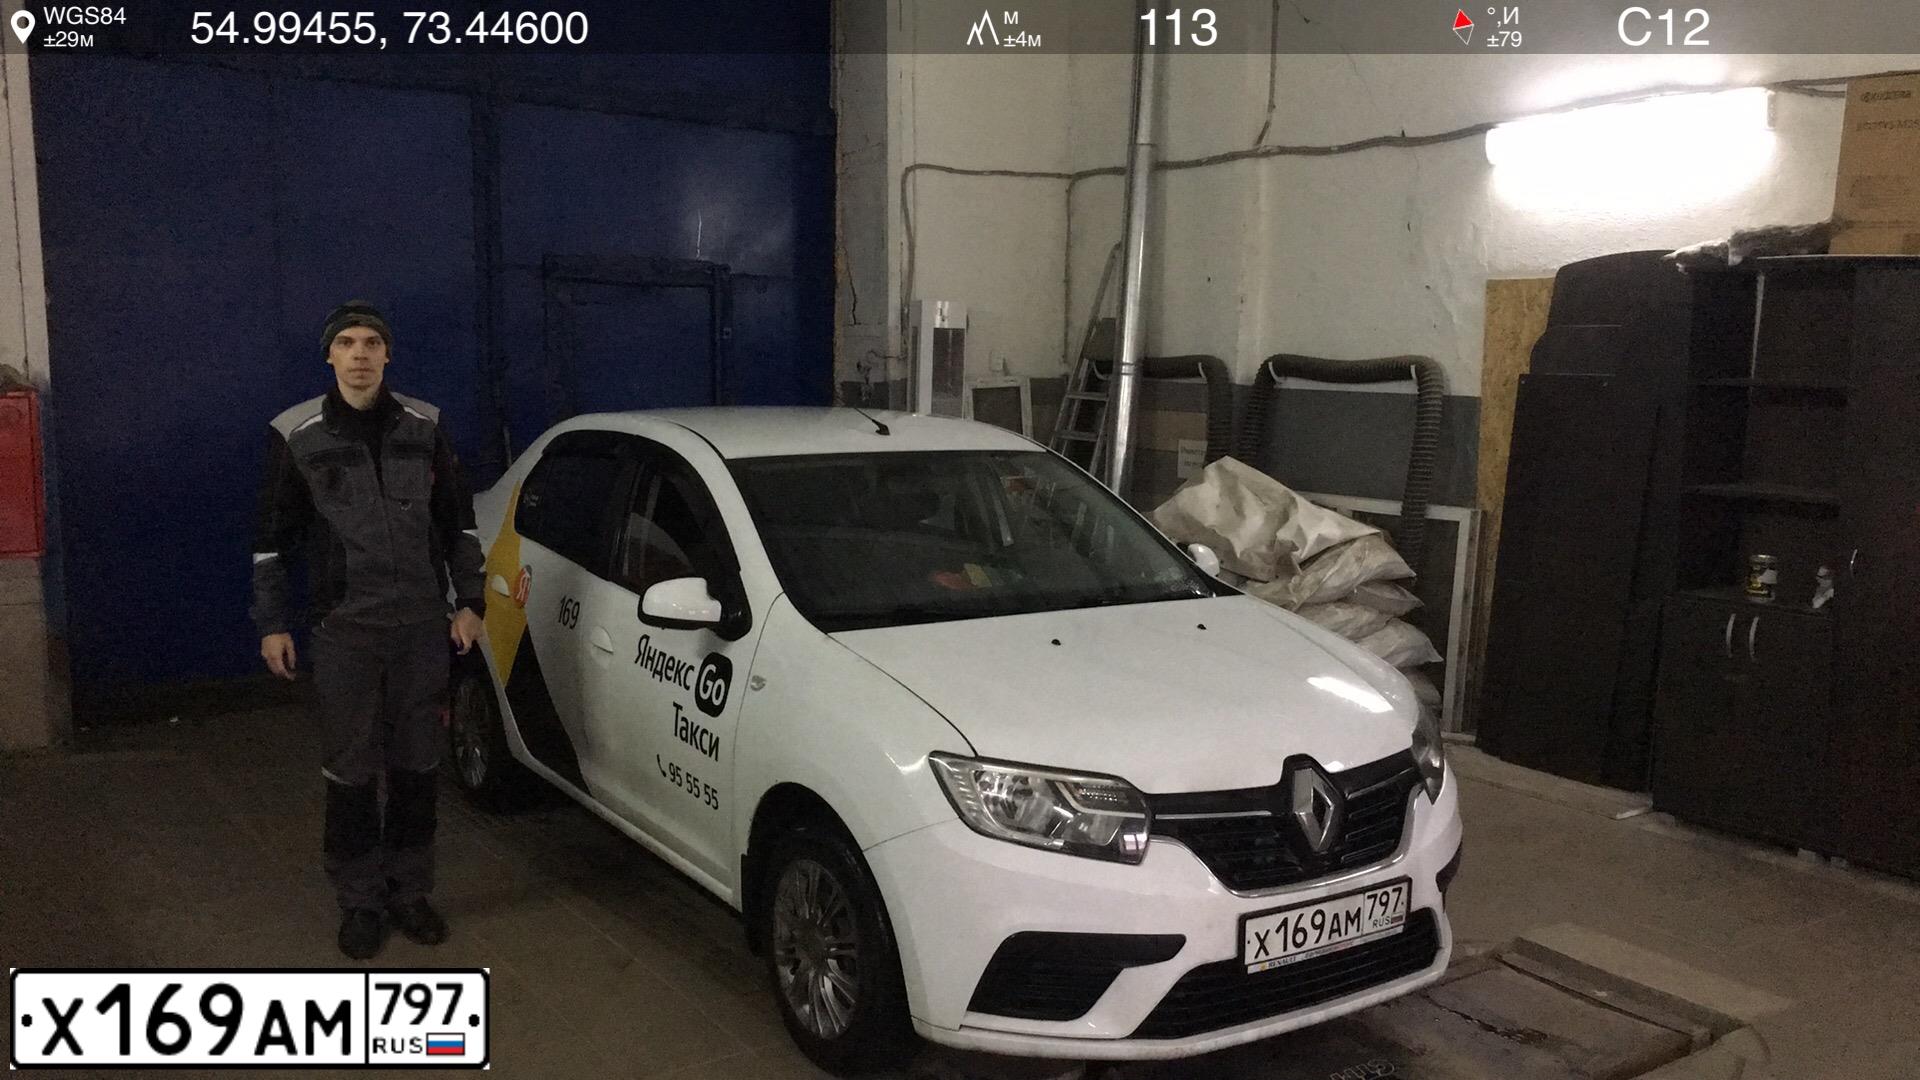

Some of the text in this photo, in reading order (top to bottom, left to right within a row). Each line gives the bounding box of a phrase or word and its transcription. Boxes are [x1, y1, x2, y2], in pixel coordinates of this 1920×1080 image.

[558, 595, 581, 630] 169
[635, 633, 726, 706] Яндекс Go
[672, 701, 720, 762] Такси
[668, 762, 719, 811] 95 55 55
[1366, 886, 1403, 921] 797
[1372, 917, 1392, 928] RUS
